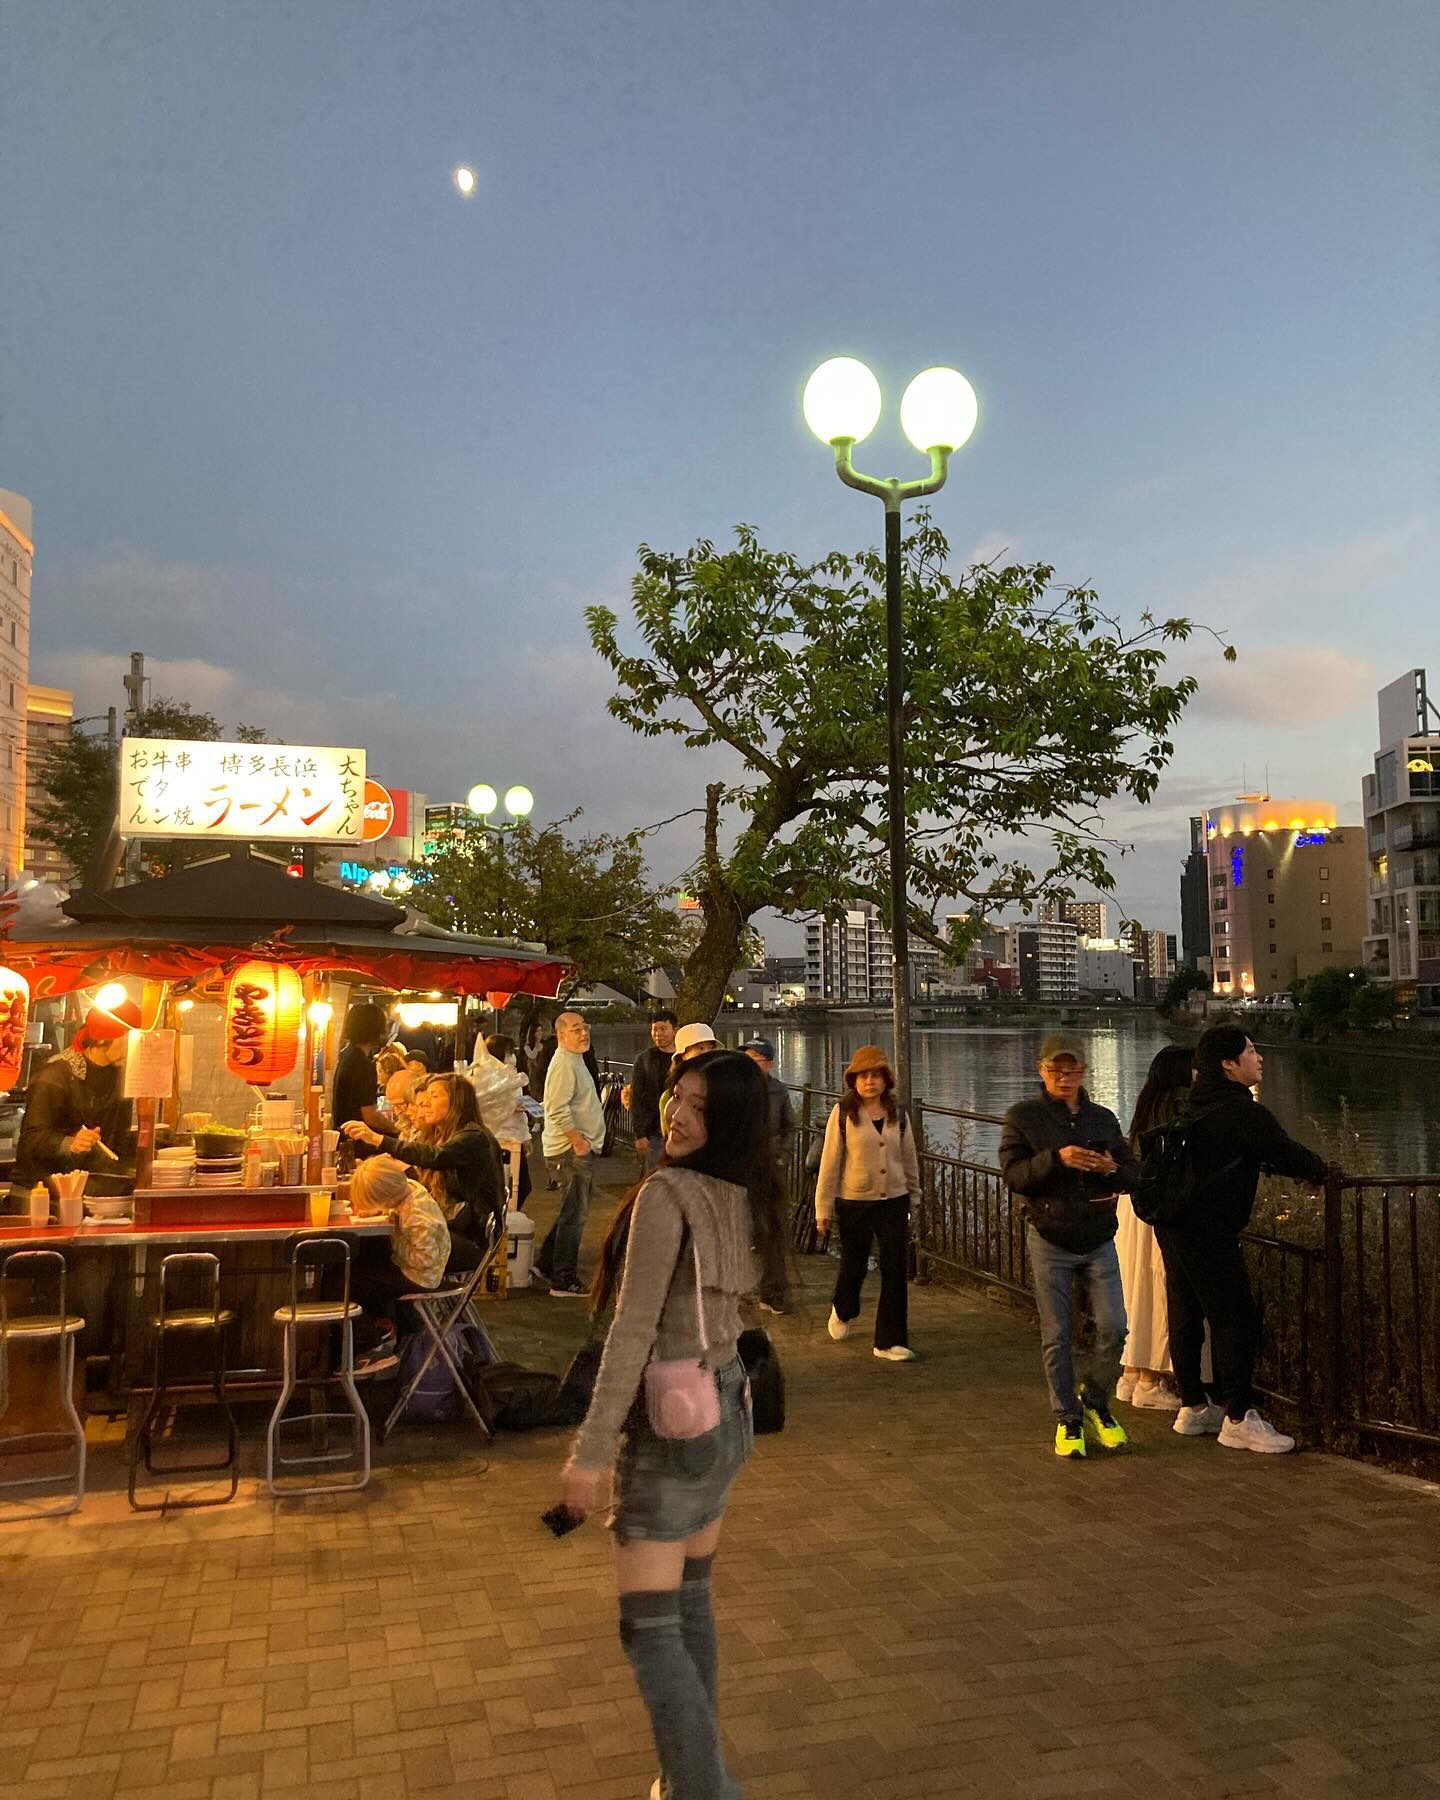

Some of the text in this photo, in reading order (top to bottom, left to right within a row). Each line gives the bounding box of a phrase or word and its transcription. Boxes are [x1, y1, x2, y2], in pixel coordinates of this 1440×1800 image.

[129, 749, 150, 824] おでん
[152, 750, 171, 824] 牛タン
[174, 751, 194, 826] 串焼
[218, 752, 320, 779] 博多長浜
[336, 755, 360, 836] 大ちゃん
[203, 783, 333, 829] ラーメン
